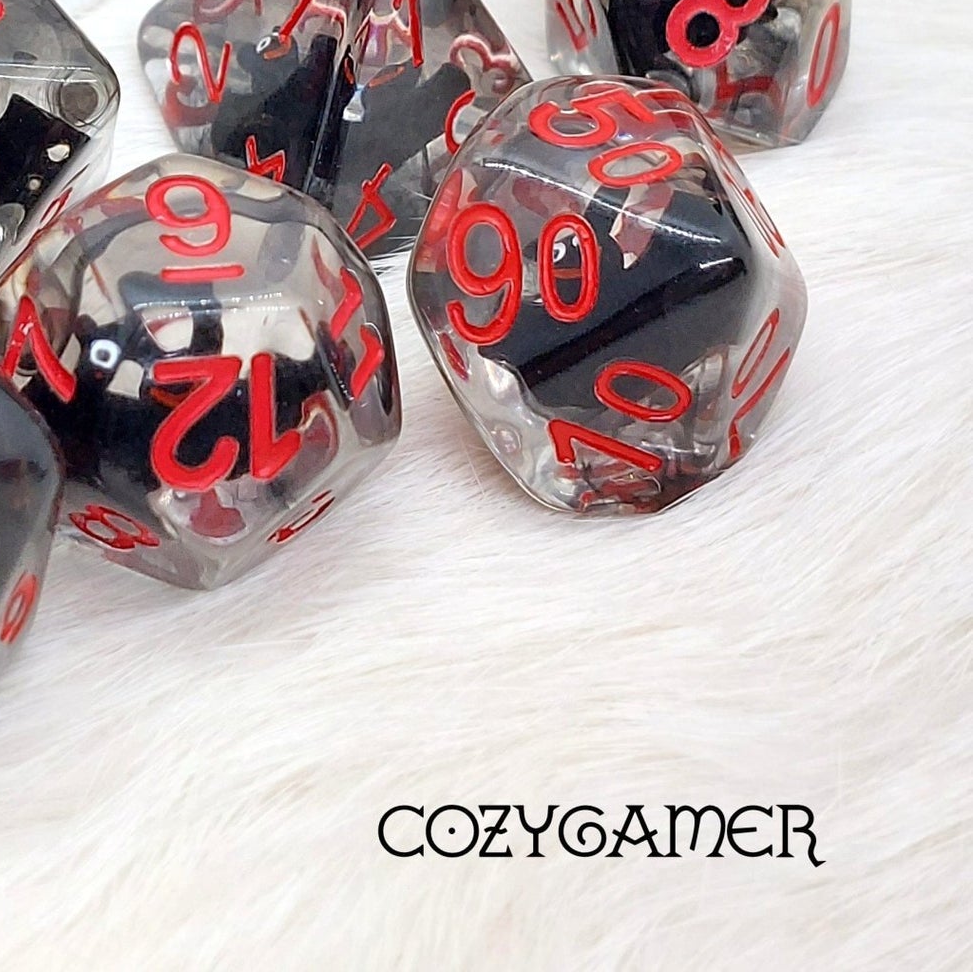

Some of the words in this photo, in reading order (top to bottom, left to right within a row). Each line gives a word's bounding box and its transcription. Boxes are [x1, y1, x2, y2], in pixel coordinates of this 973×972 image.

[170, 21, 233, 105] 2
[444, 201, 601, 346] 90
[150, 351, 303, 491] 12
